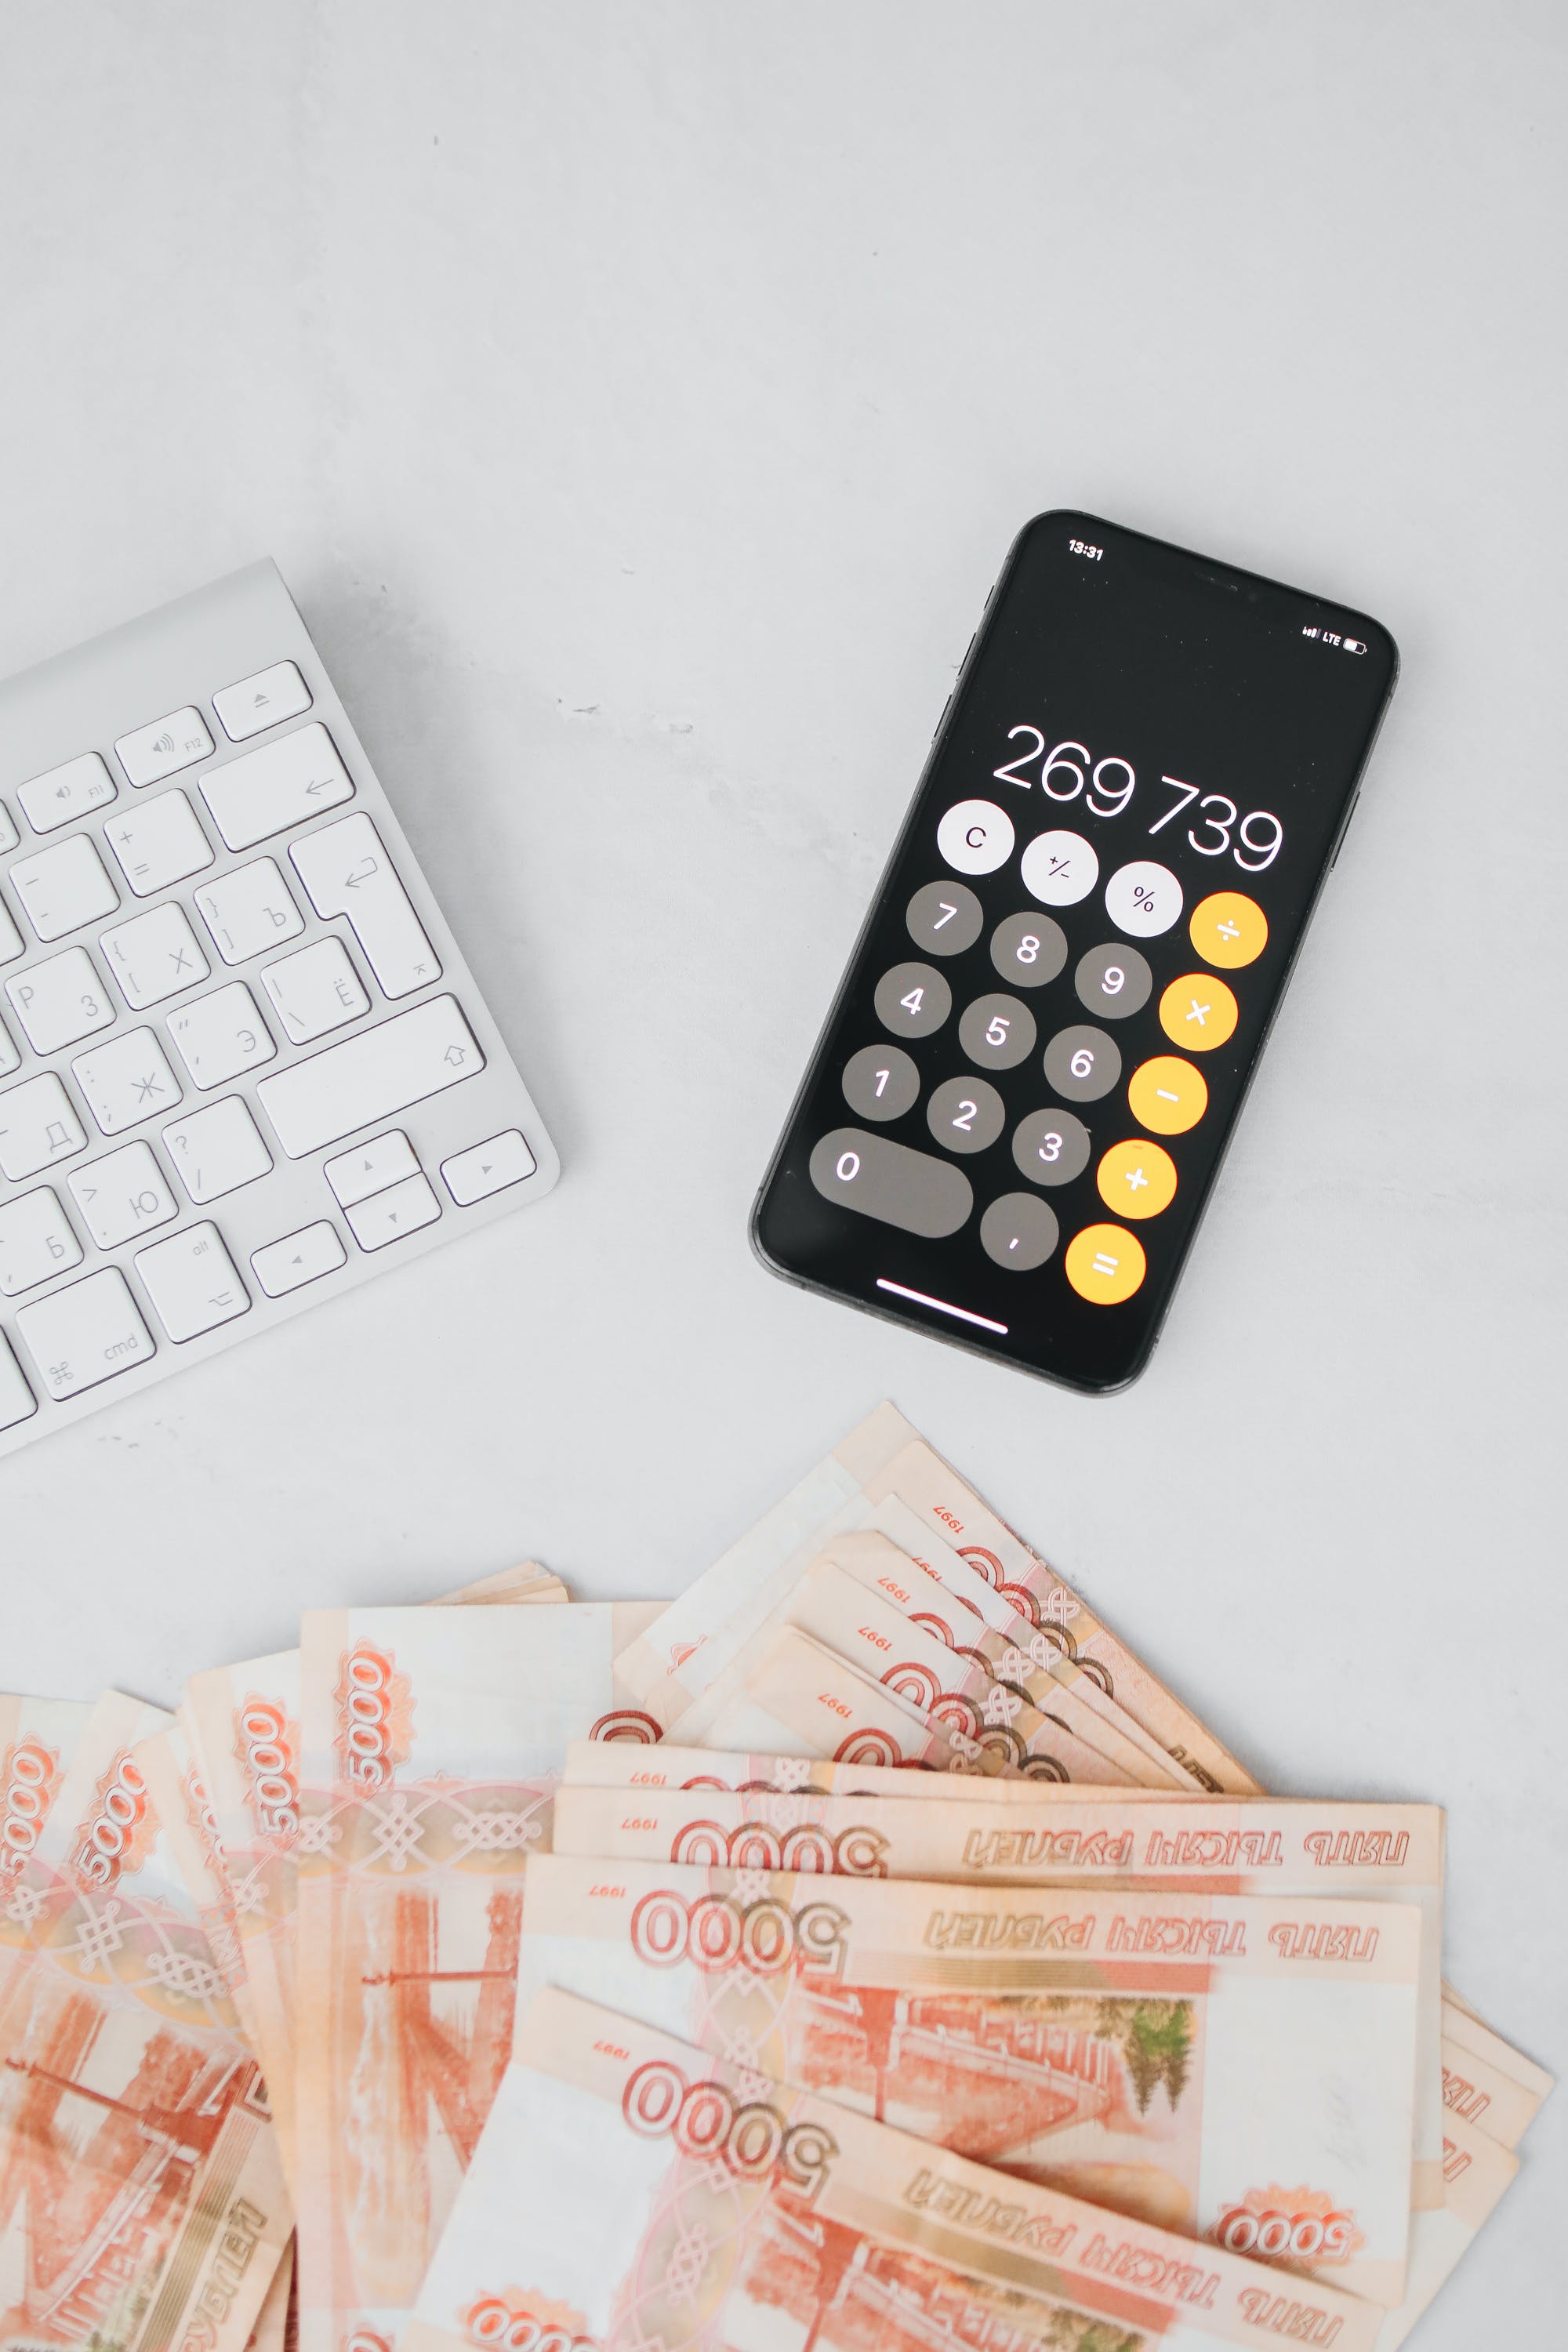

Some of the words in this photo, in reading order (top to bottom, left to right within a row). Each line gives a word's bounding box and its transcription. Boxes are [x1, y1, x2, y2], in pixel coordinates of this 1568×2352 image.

[1069, 539, 1103, 561] 13:31
[1322, 631, 1341, 647] LTE
[185, 738, 203, 752] F12
[88, 785, 106, 798] F11
[993, 724, 1135, 818] 269
[1148, 775, 1283, 872] 739
[966, 827, 985, 848] C
[1134, 887, 1154, 912] %
[263, 908, 286, 927] Ъ
[934, 903, 957, 929] 7
[1017, 935, 1040, 963] 8
[334, 978, 354, 1007] Ё
[1102, 967, 1124, 994] 9
[901, 988, 924, 1014] 4
[236, 1030, 257, 1053] Э
[986, 1017, 1010, 1046] 5
[1071, 1050, 1094, 1077] 6
[131, 1072, 165, 1103] Ж
[876, 1070, 889, 1097] 1
[953, 1101, 977, 1131] 2
[45, 1121, 74, 1153] Д
[1039, 1133, 1062, 1161] 3
[837, 1152, 859, 1181] 0
[1126, 1169, 1148, 1190] +
[129, 1190, 158, 1219] Ю
[45, 1236, 65, 1259] Б
[192, 1240, 210, 1258] alt
[1093, 1253, 1118, 1275] =
[103, 1334, 139, 1362] cmd
[932, 1505, 964, 1534] 1997
[877, 1576, 912, 1604] 1997
[857, 1625, 893, 1652] 1997
[817, 1692, 855, 1719] 1997
[347, 1656, 386, 1787] 5000
[241, 1709, 298, 1838] 5000
[629, 1771, 668, 1786] 1997
[77, 1755, 148, 1886] 5000
[620, 1818, 658, 1831] 1997
[961, 1830, 1132, 1869] РУБЛЕЙ
[1146, 1830, 1283, 1867] ТЫСЯЧ
[1305, 1831, 1410, 1867] ПЯТЬ
[590, 1885, 626, 1899] 1997
[632, 1889, 852, 1979] 5000
[927, 1911, 1095, 1951] РУБЛЕЙ
[1106, 1916, 1247, 1957] ТЫСЯЧ
[1268, 1922, 1380, 1962] ПЯТЬ
[593, 2041, 630, 2060] 1997
[622, 2061, 840, 2201] 5000
[903, 2166, 1077, 2258] РУБЛЕЙ
[1225, 2212, 1354, 2259] 5000
[1080, 2234, 1222, 2310] ТЫСЯЧ
[1236, 2285, 1346, 2350] ПЯТЬ
